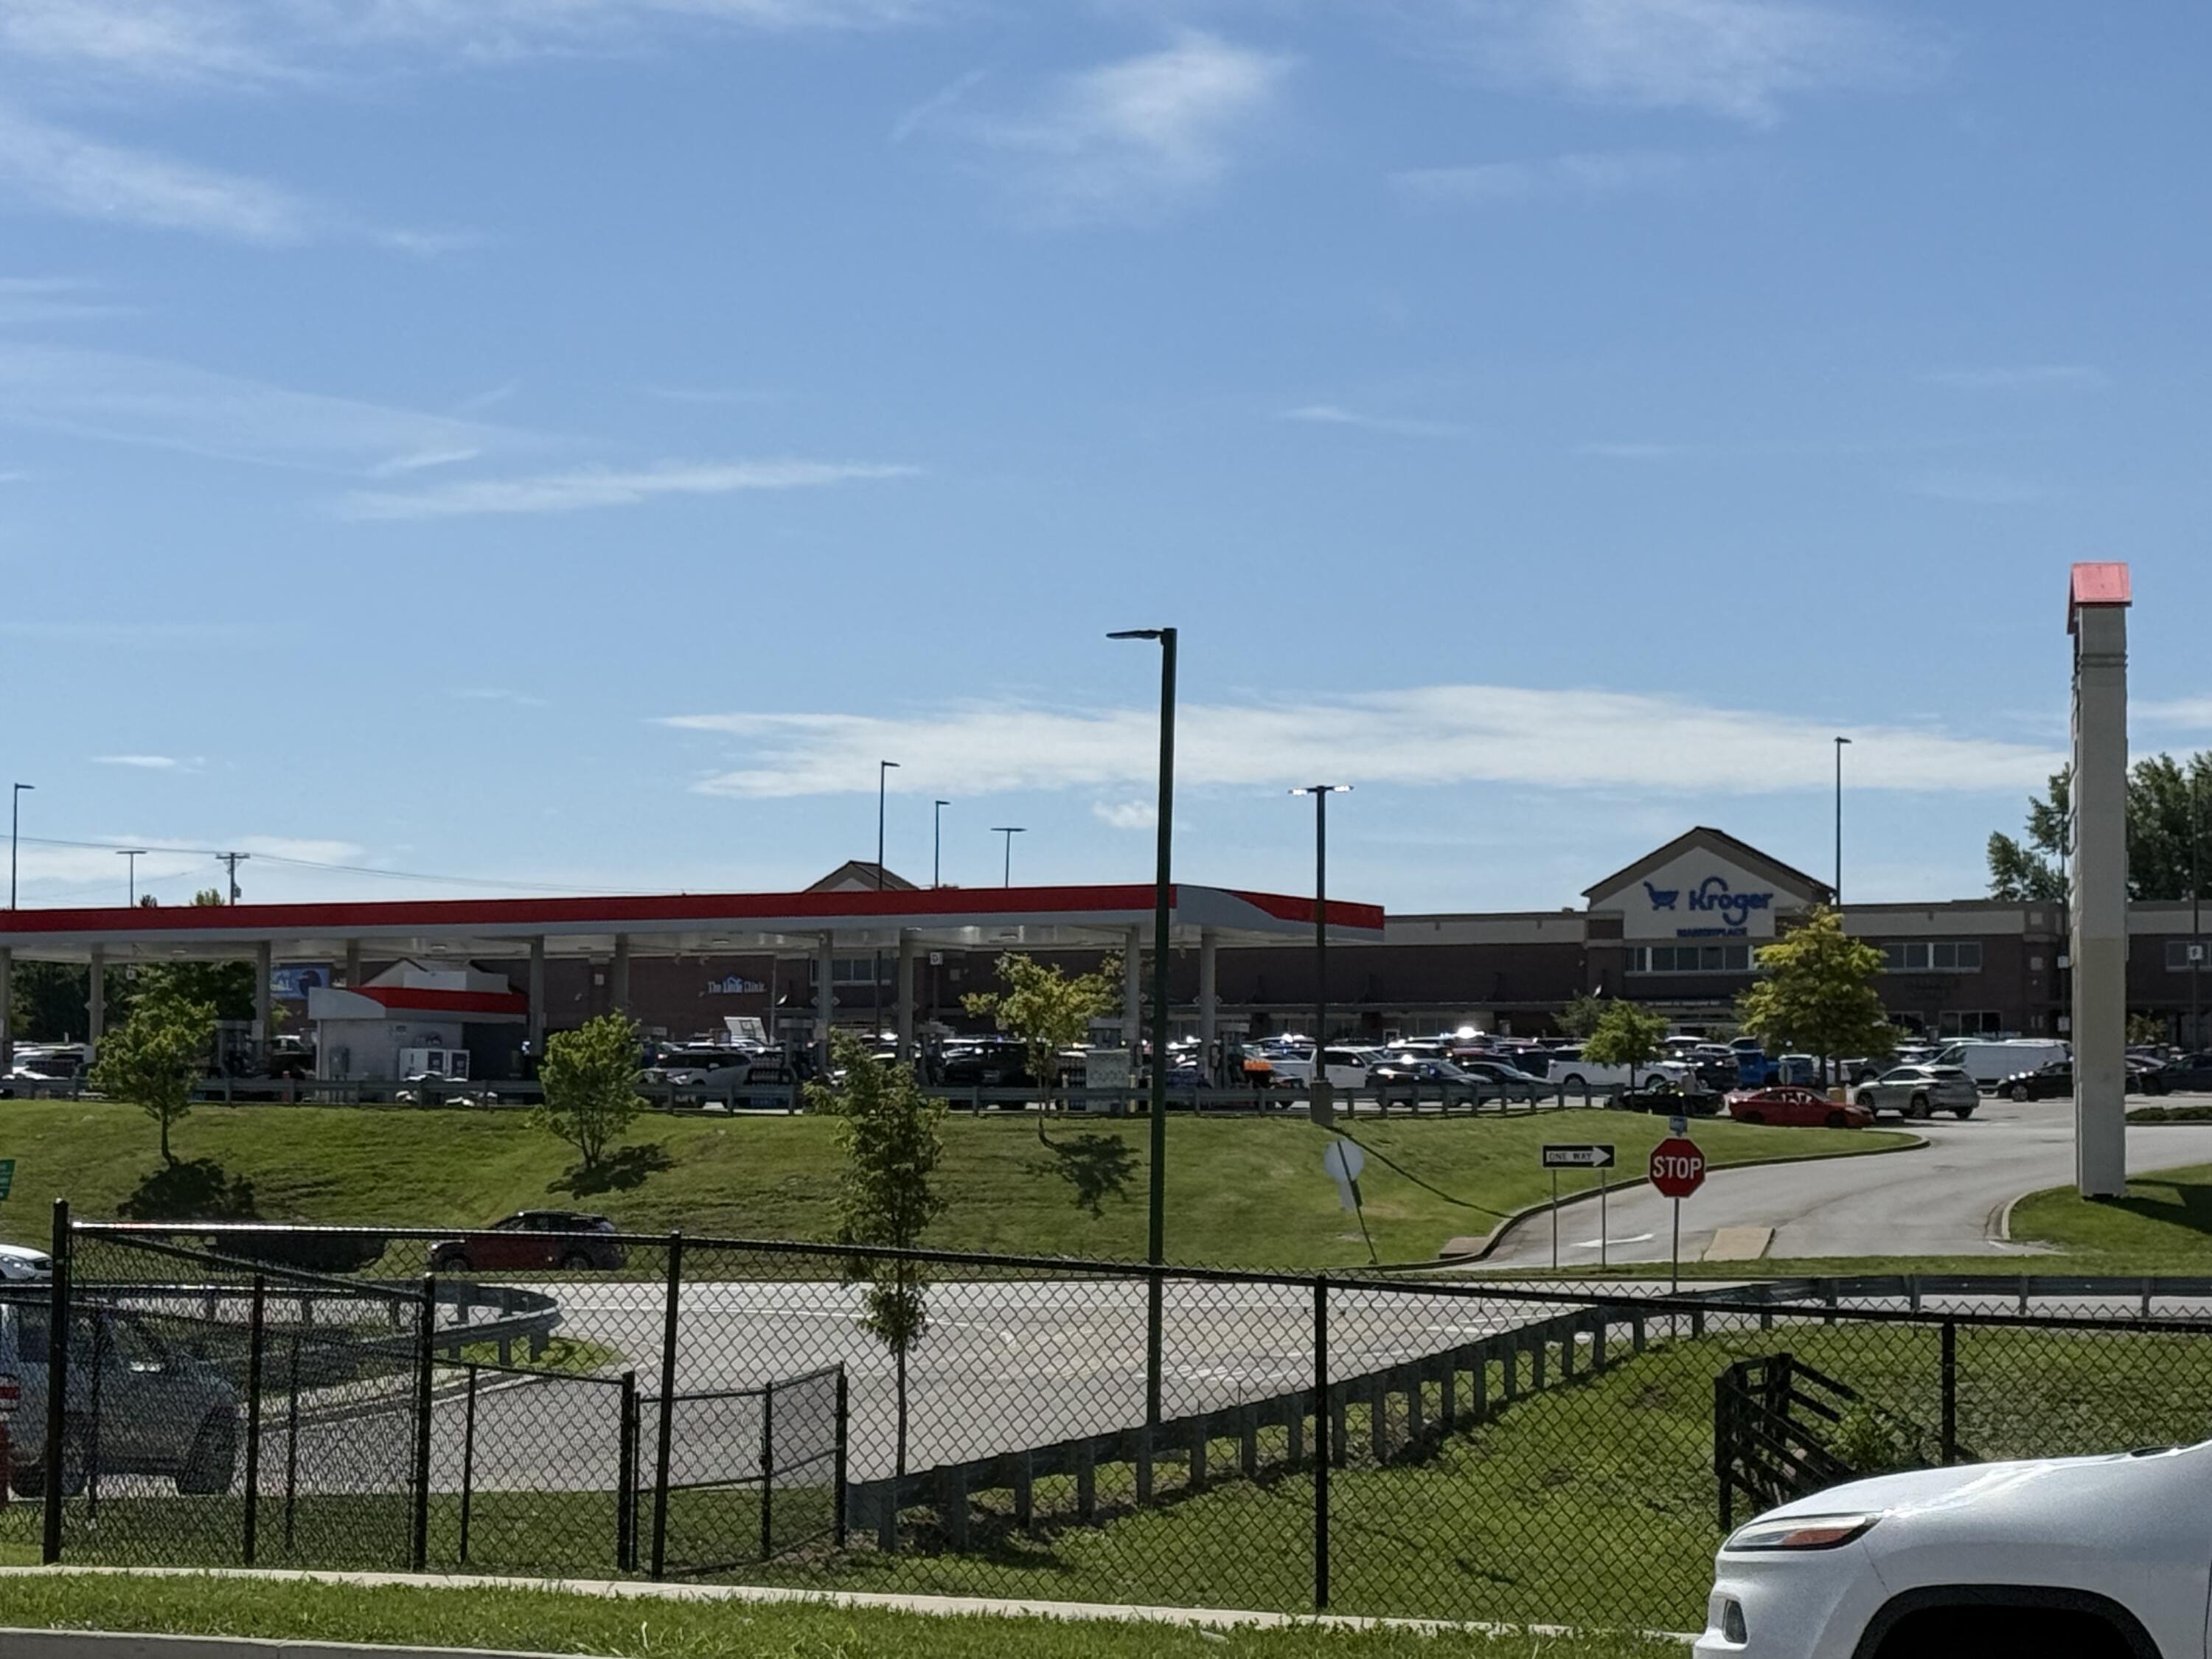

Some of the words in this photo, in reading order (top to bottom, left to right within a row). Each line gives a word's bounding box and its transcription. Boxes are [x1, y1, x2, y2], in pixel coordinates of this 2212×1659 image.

[1689, 876, 1773, 926] Kroger
[708, 981, 722, 993] The
[1549, 1152, 1566, 1161] ONE
[1652, 1156, 1703, 1179] STOP
